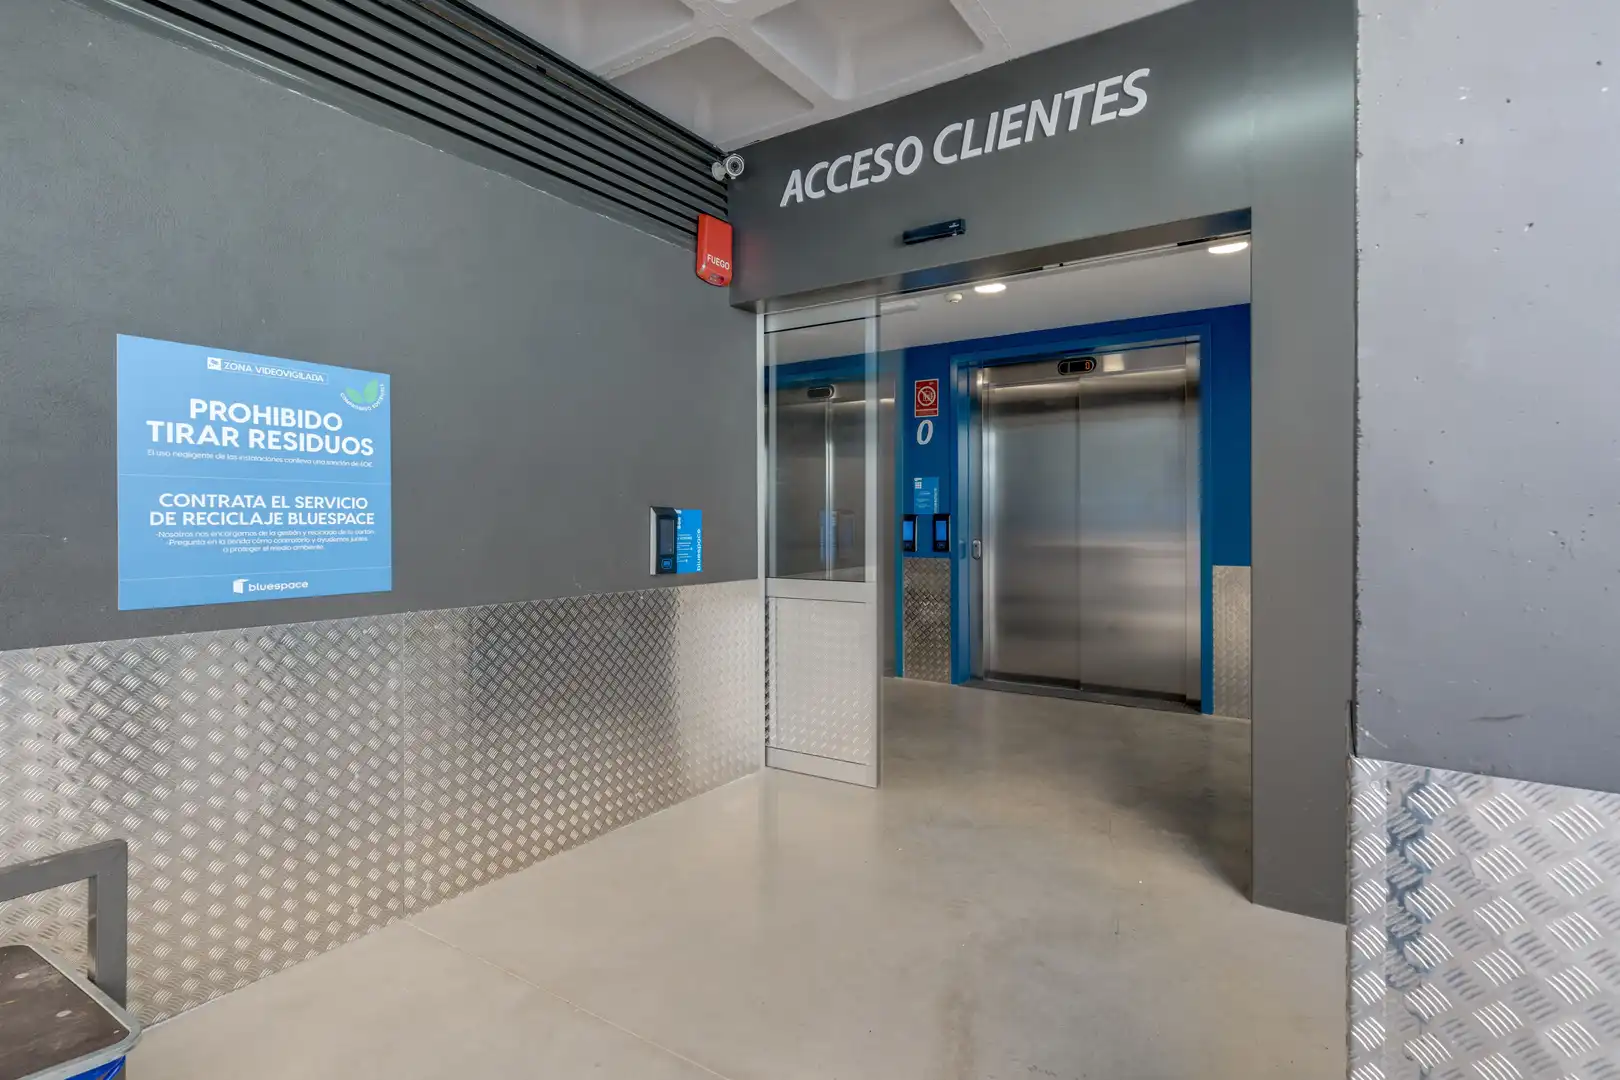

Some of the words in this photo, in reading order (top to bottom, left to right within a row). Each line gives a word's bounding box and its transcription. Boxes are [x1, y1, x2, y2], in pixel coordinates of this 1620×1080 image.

[779, 135, 923, 207] ACCESO
[933, 67, 1150, 165] CLIENTES
[706, 253, 730, 270] FUEGO
[223, 361, 252, 372] ZONA
[255, 366, 324, 382] VIDEOVIGILADA
[189, 398, 343, 431] PROHIBIDO
[146, 420, 240, 448] TIRAR
[248, 428, 374, 456] RESIDUOS
[916, 419, 934, 445] 0
[147, 448, 154, 456] El
[172, 451, 214, 460] negligente
[215, 452, 226, 460] de
[227, 453, 238, 461] las
[159, 493, 267, 509] CONTRATA
[271, 495, 290, 509] EL
[294, 495, 368, 510] SERVICIO
[149, 511, 177, 526] DE
[182, 511, 284, 526] RECICLAJE
[287, 512, 375, 526] BLUESPACE
[210, 530, 258, 539] encargamos
[258, 529, 268, 537] de
[248, 580, 309, 593] bluespace
